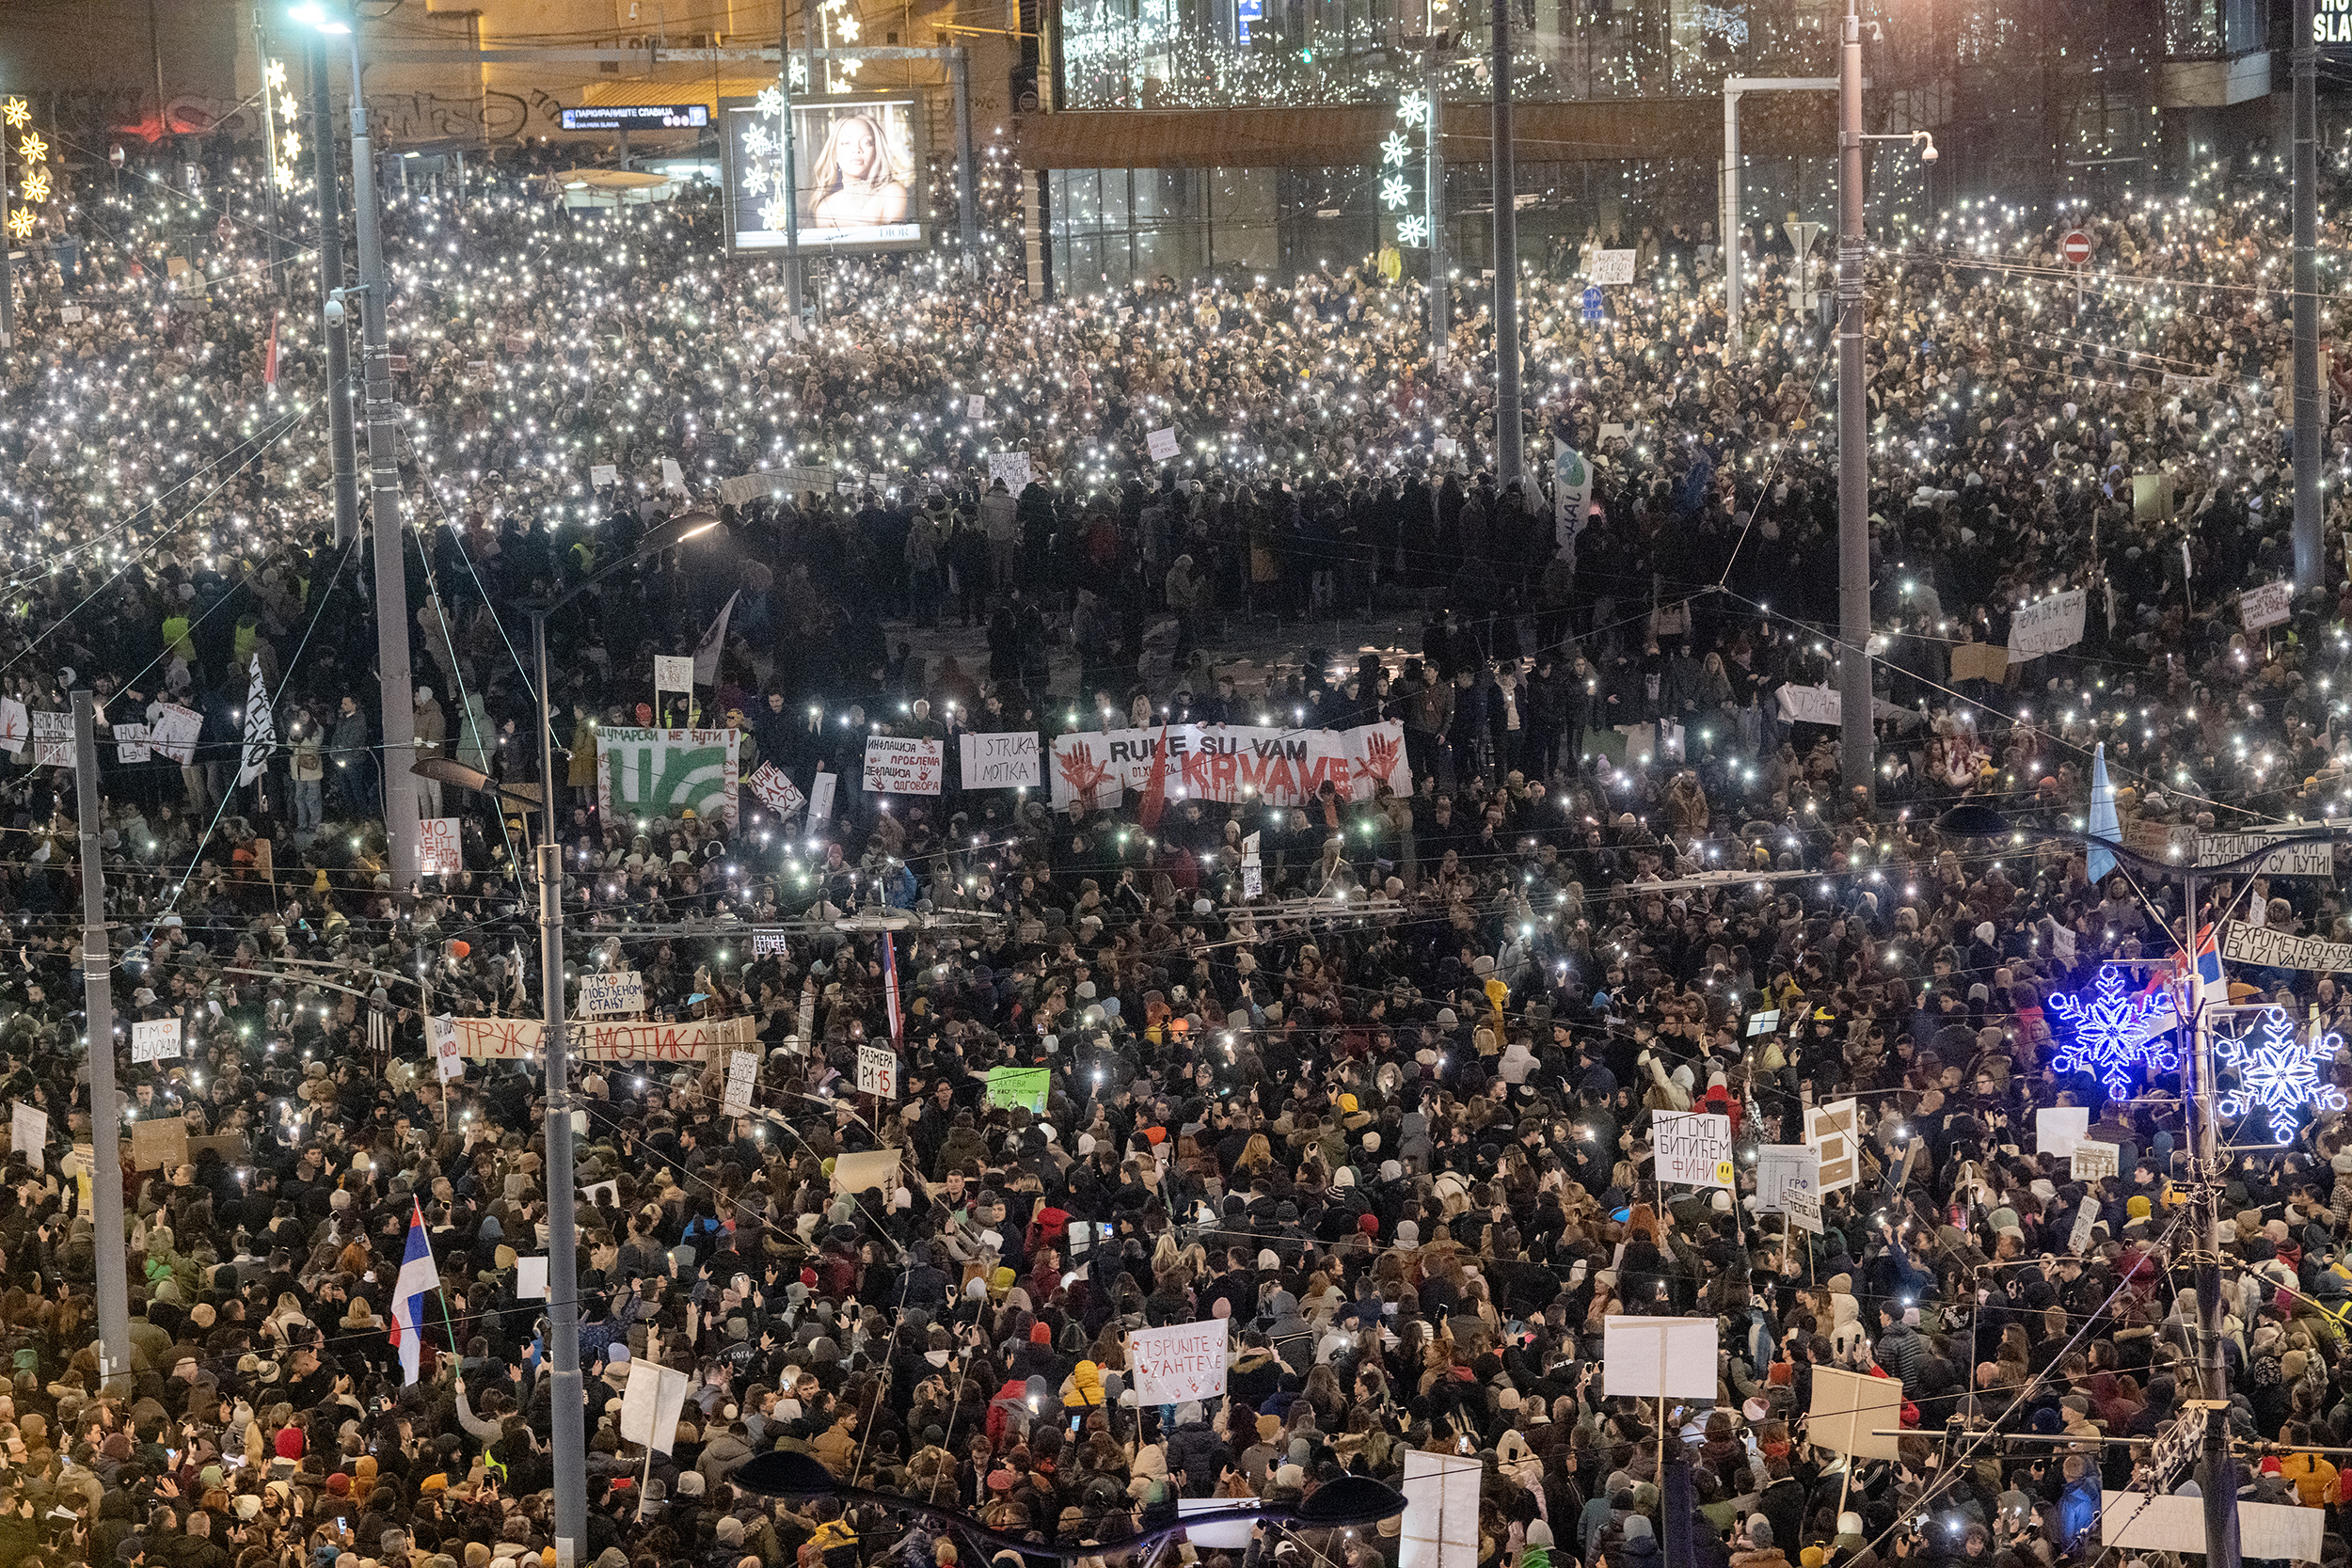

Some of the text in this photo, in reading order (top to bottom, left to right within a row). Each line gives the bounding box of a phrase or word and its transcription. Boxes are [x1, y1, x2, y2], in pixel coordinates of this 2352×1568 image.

[2313, 13, 2352, 42] SLA
[879, 228, 909, 237] DIOR
[668, 731, 683, 741] НЕ
[867, 739, 916, 753] ИНФЛАЦИЈА
[986, 736, 1037, 756] STRUKA
[1200, 736, 1237, 755] SU
[1250, 740, 1308, 761] VAM
[890, 755, 940, 767] ПРОБЛЕМА
[864, 766, 911, 779] ДЕФЛАЦИЈА
[1180, 751, 1356, 799] KRVAVE
[894, 781, 939, 791] ОДГОВОРА
[2269, 855, 2287, 873] СУ
[589, 997, 624, 1011] СТАЊУ
[859, 1048, 894, 1069] РАЗМЕРА
[1659, 1115, 1679, 1135] МИ
[1689, 1117, 1716, 1138] СМО
[1672, 1157, 1714, 1182] ФИНИ
[1145, 1336, 1211, 1359] ISPUNITE
[1151, 1354, 1222, 1379] ZAHTEVE
